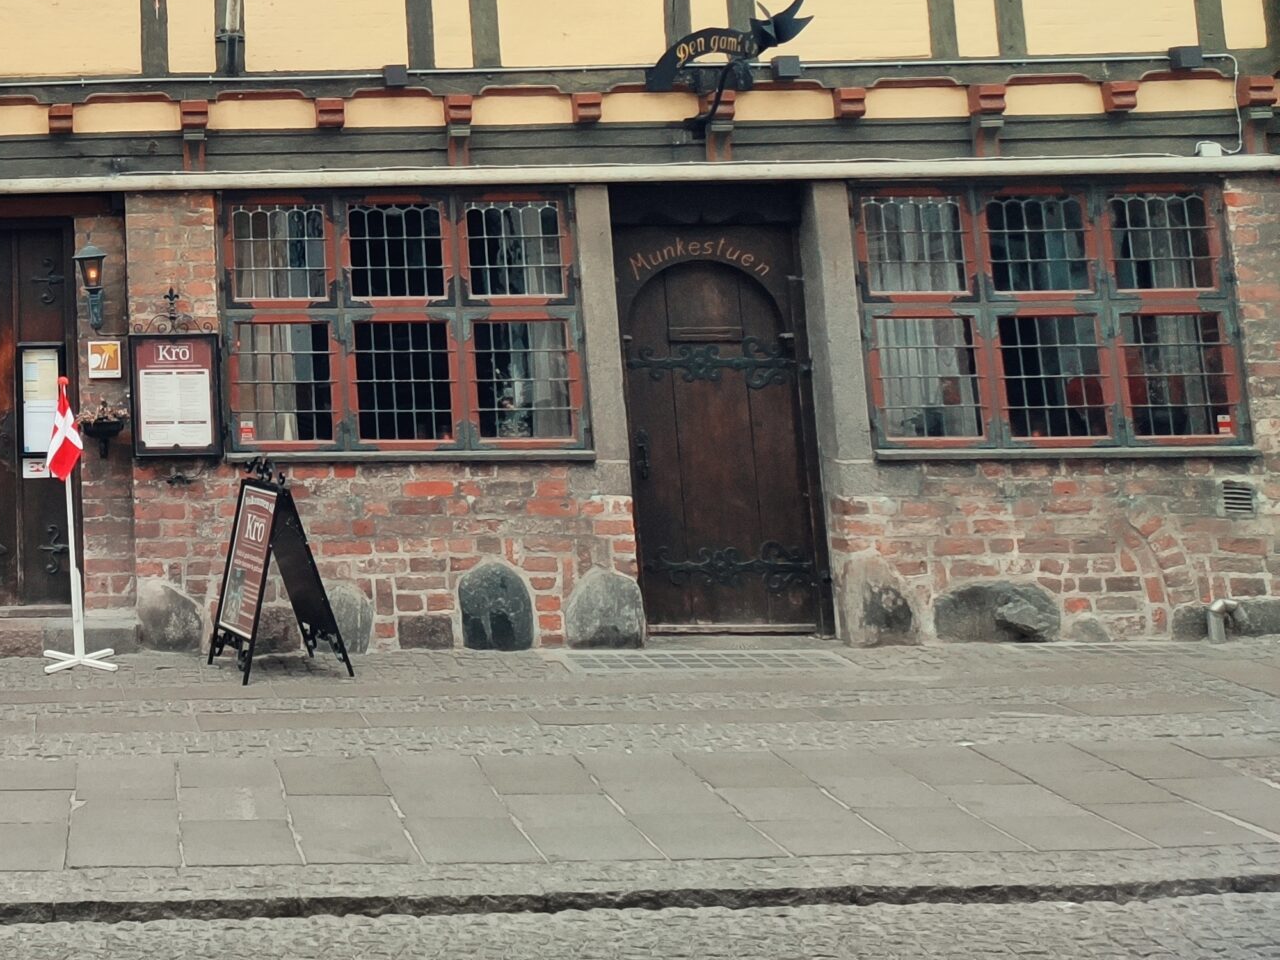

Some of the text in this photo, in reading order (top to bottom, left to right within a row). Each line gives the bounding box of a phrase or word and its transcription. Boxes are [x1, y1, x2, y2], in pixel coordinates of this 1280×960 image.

[676, 37, 705, 68] Den
[629, 237, 770, 281] Munkestuen
[157, 344, 190, 361] Kro
[244, 513, 266, 543] Kro
